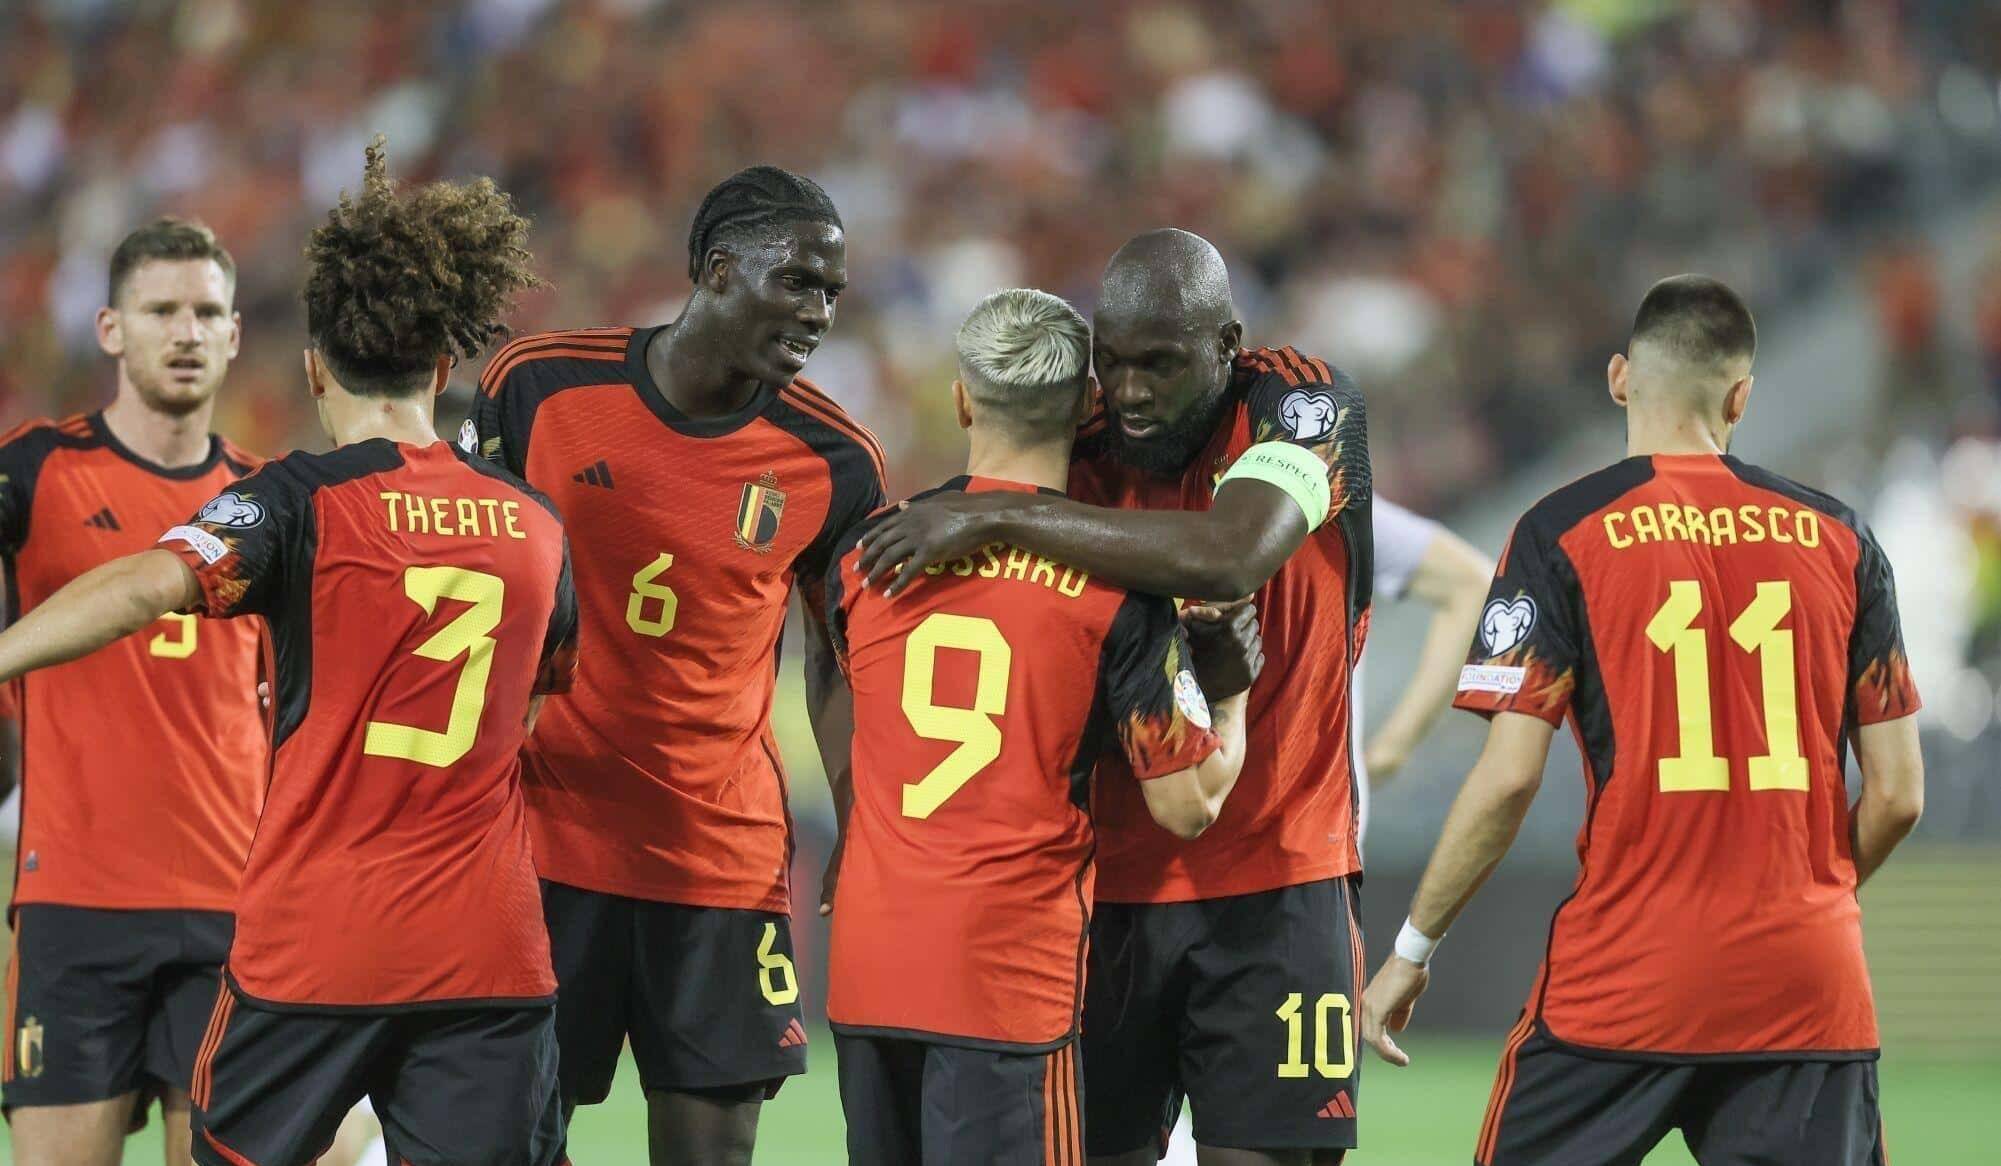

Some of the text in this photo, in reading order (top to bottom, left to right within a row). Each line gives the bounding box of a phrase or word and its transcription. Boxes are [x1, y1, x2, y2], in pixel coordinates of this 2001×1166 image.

[379, 491, 527, 540] THEATE
[1603, 502, 1820, 549] CARRASCO
[626, 552, 678, 637] 6
[363, 566, 505, 768] 3
[1644, 580, 1810, 793] 11
[901, 612, 1012, 820] 9
[756, 922, 799, 1006] 6
[1275, 992, 1355, 1079] 10
